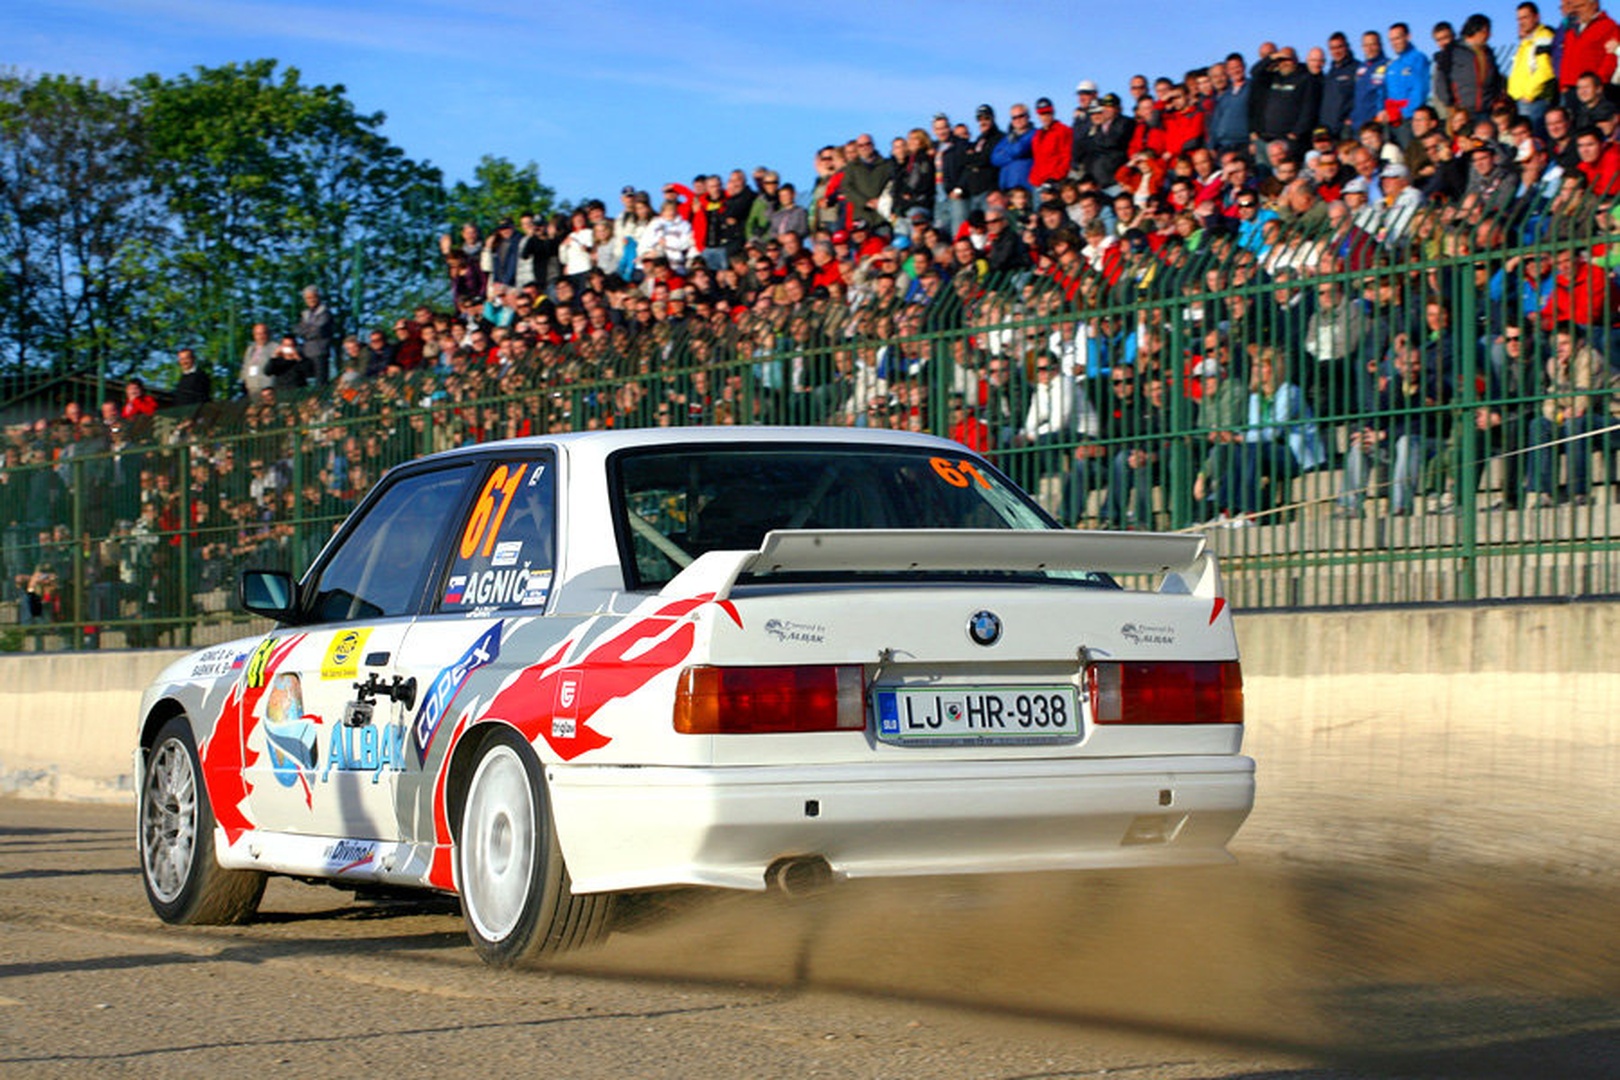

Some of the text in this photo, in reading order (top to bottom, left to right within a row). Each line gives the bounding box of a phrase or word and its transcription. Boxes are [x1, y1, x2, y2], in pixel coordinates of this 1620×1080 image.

[929, 456, 993, 490] 61
[460, 463, 529, 560] 61
[461, 561, 531, 606] AGNIČ
[415, 634, 493, 750] COPEX
[906, 694, 1068, 729] LJ HR-938
[322, 719, 408, 784] ALBAK
